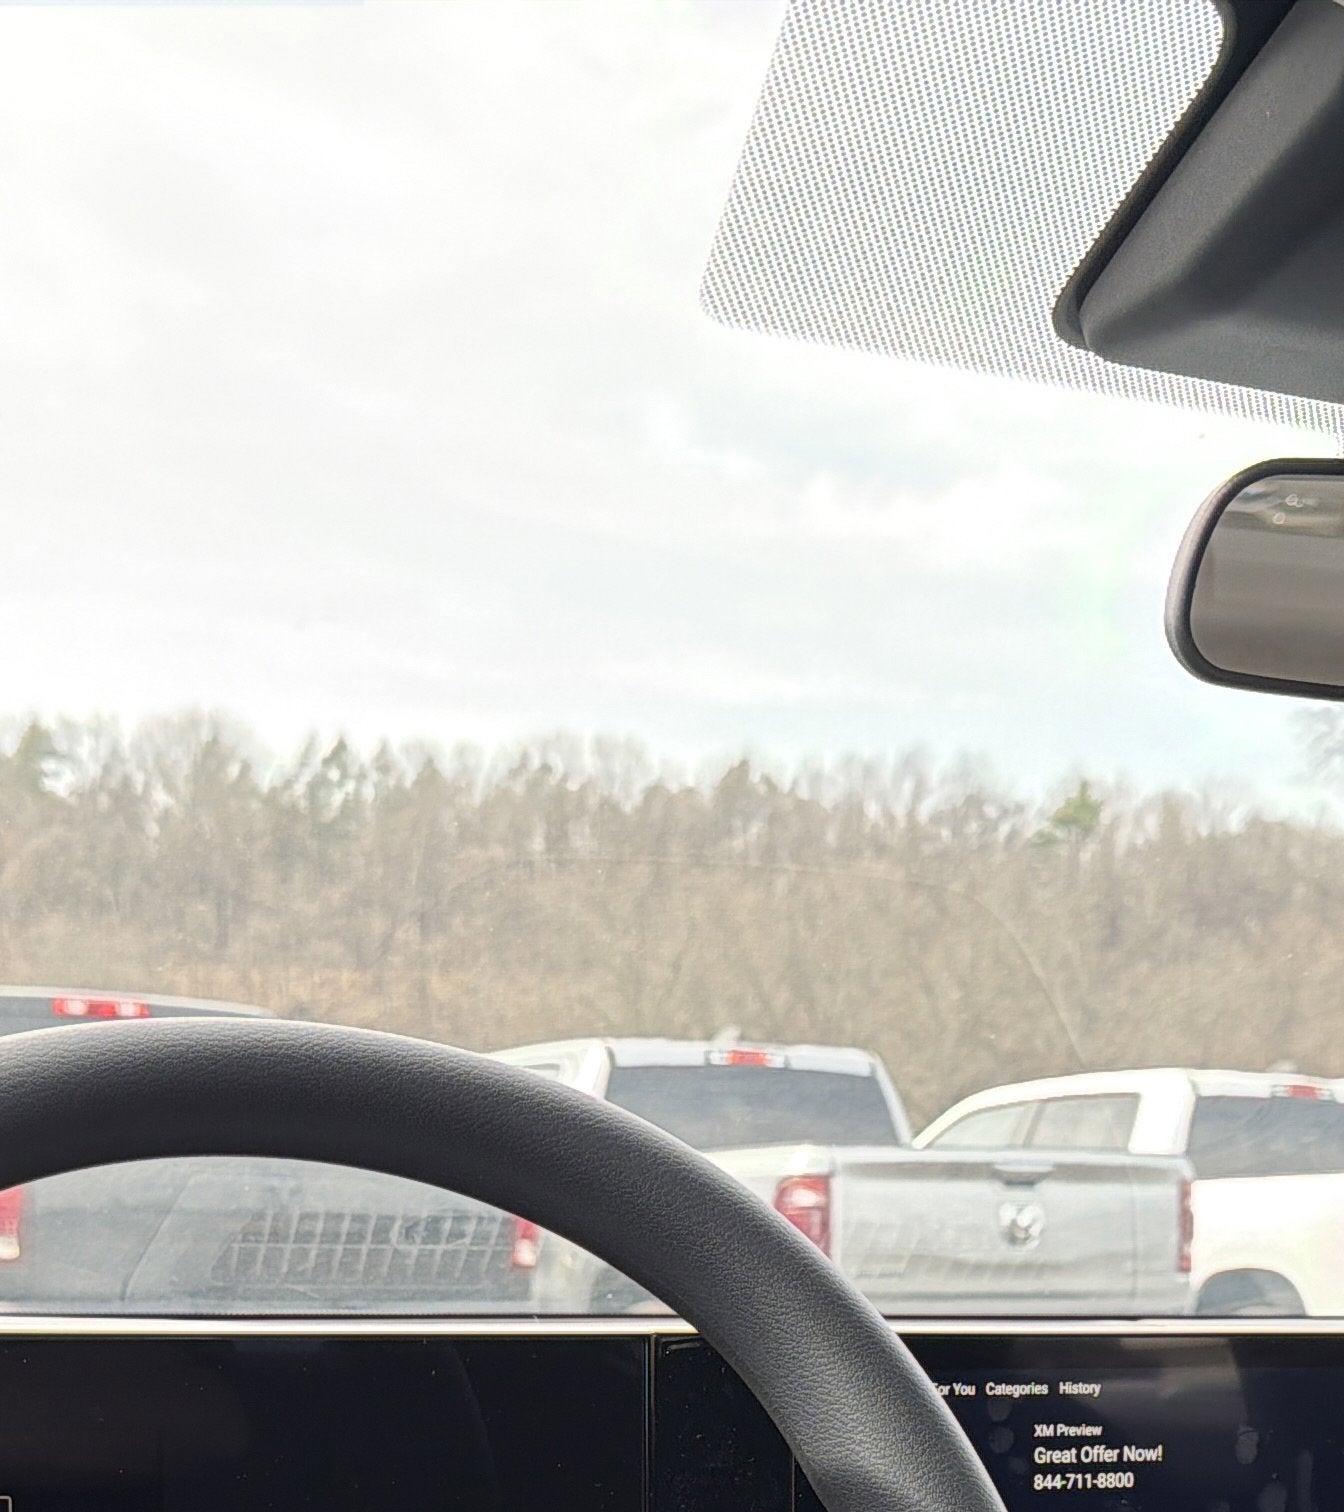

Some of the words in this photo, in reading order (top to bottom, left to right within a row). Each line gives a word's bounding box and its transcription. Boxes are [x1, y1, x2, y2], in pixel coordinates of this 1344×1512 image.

[954, 1382, 976, 1396] You
[985, 1382, 1049, 1398] Categories
[1059, 1382, 1102, 1397] History
[1034, 1424, 1054, 1437] XM
[1056, 1424, 1103, 1437] Preview
[1034, 1447, 1077, 1464] Great
[1080, 1447, 1120, 1463] Offer
[1123, 1445, 1163, 1461] Now!
[1034, 1472, 1134, 1490] 844-711-8800
